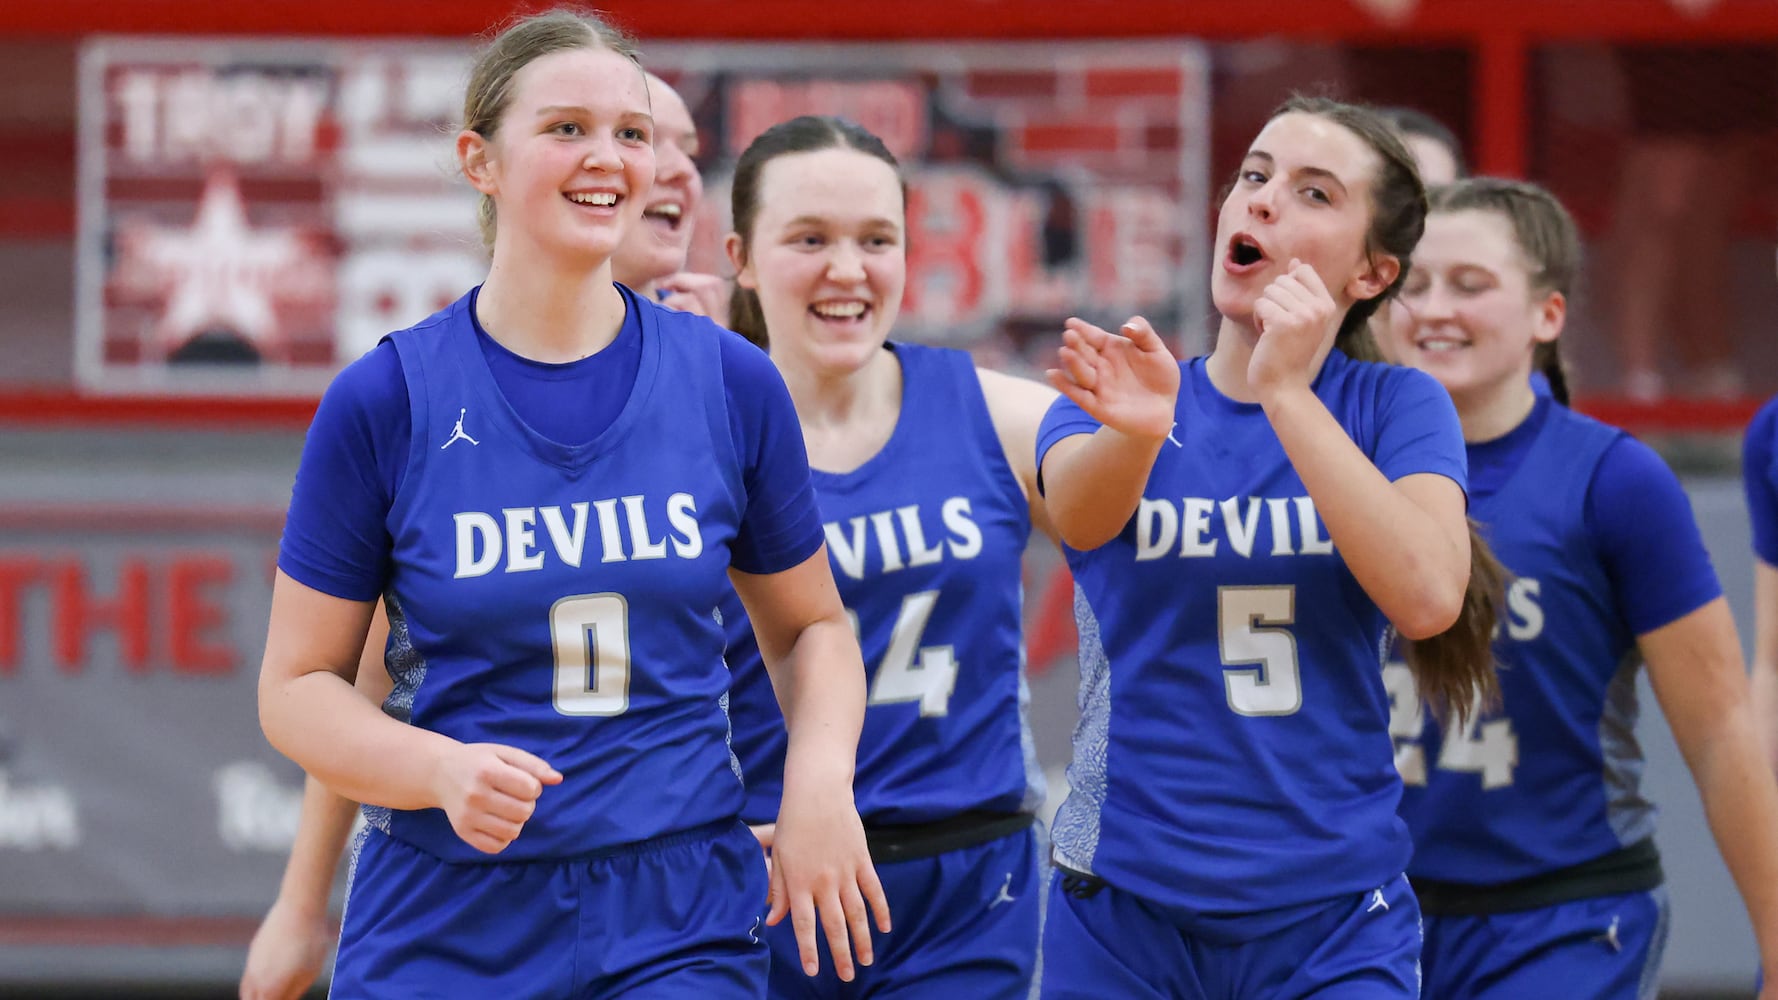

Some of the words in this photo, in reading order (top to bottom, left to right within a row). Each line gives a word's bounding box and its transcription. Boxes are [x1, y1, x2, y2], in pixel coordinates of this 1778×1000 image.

[453, 492, 703, 579] DEVILS
[823, 496, 983, 581] VILS
[1135, 495, 1333, 562] DEVIL
[549, 592, 631, 717] 0
[844, 589, 960, 718] 4
[1217, 584, 1302, 717] 5
